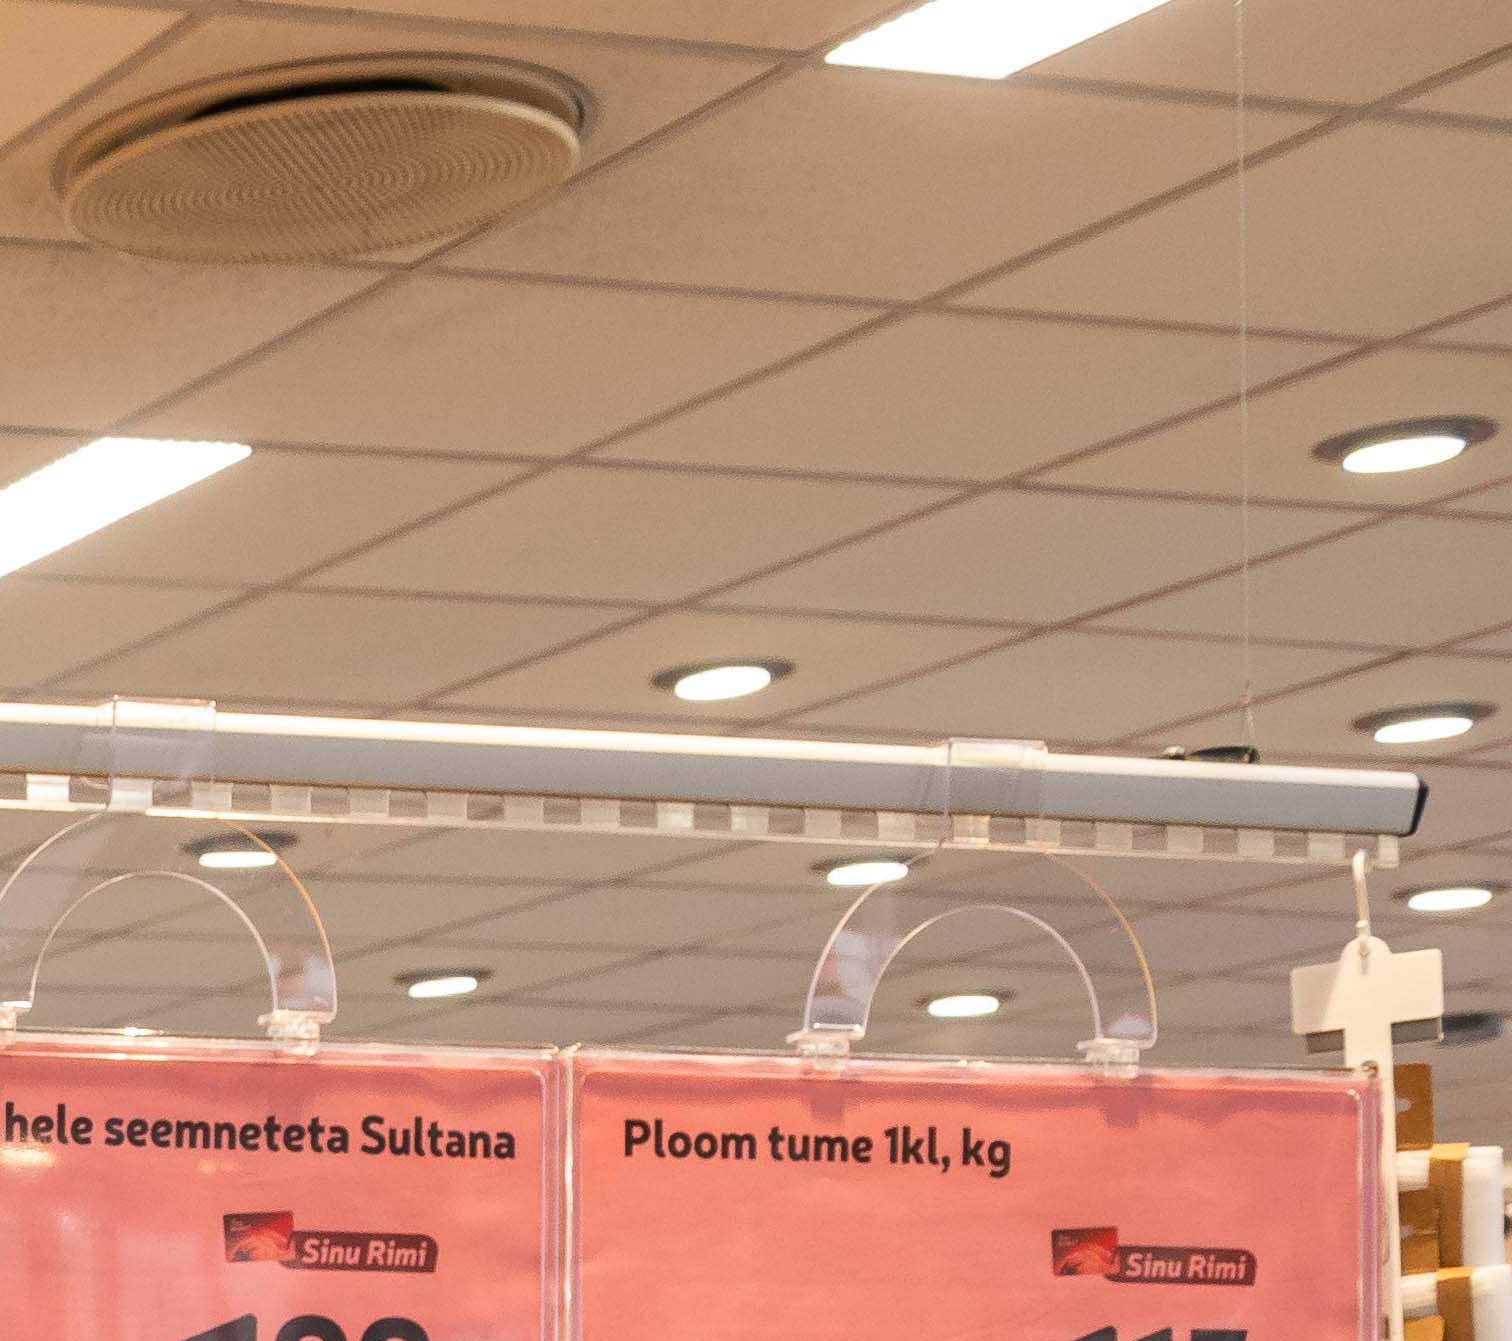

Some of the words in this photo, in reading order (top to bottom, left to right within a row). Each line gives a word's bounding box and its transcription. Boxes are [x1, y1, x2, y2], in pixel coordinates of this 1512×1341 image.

[4, 1100, 94, 1146] hele
[104, 1115, 349, 1154] seemneteta
[360, 1115, 516, 1160] Sultana
[624, 1118, 757, 1161] Ploom
[767, 1126, 874, 1164] tume
[883, 1125, 951, 1174] 1kl,
[961, 1127, 1011, 1179] kg
[300, 1238, 361, 1265] Sinu
[366, 1239, 428, 1267] Rimi
[1125, 1252, 1183, 1278] Sinu
[1186, 1253, 1247, 1280] Rimi
